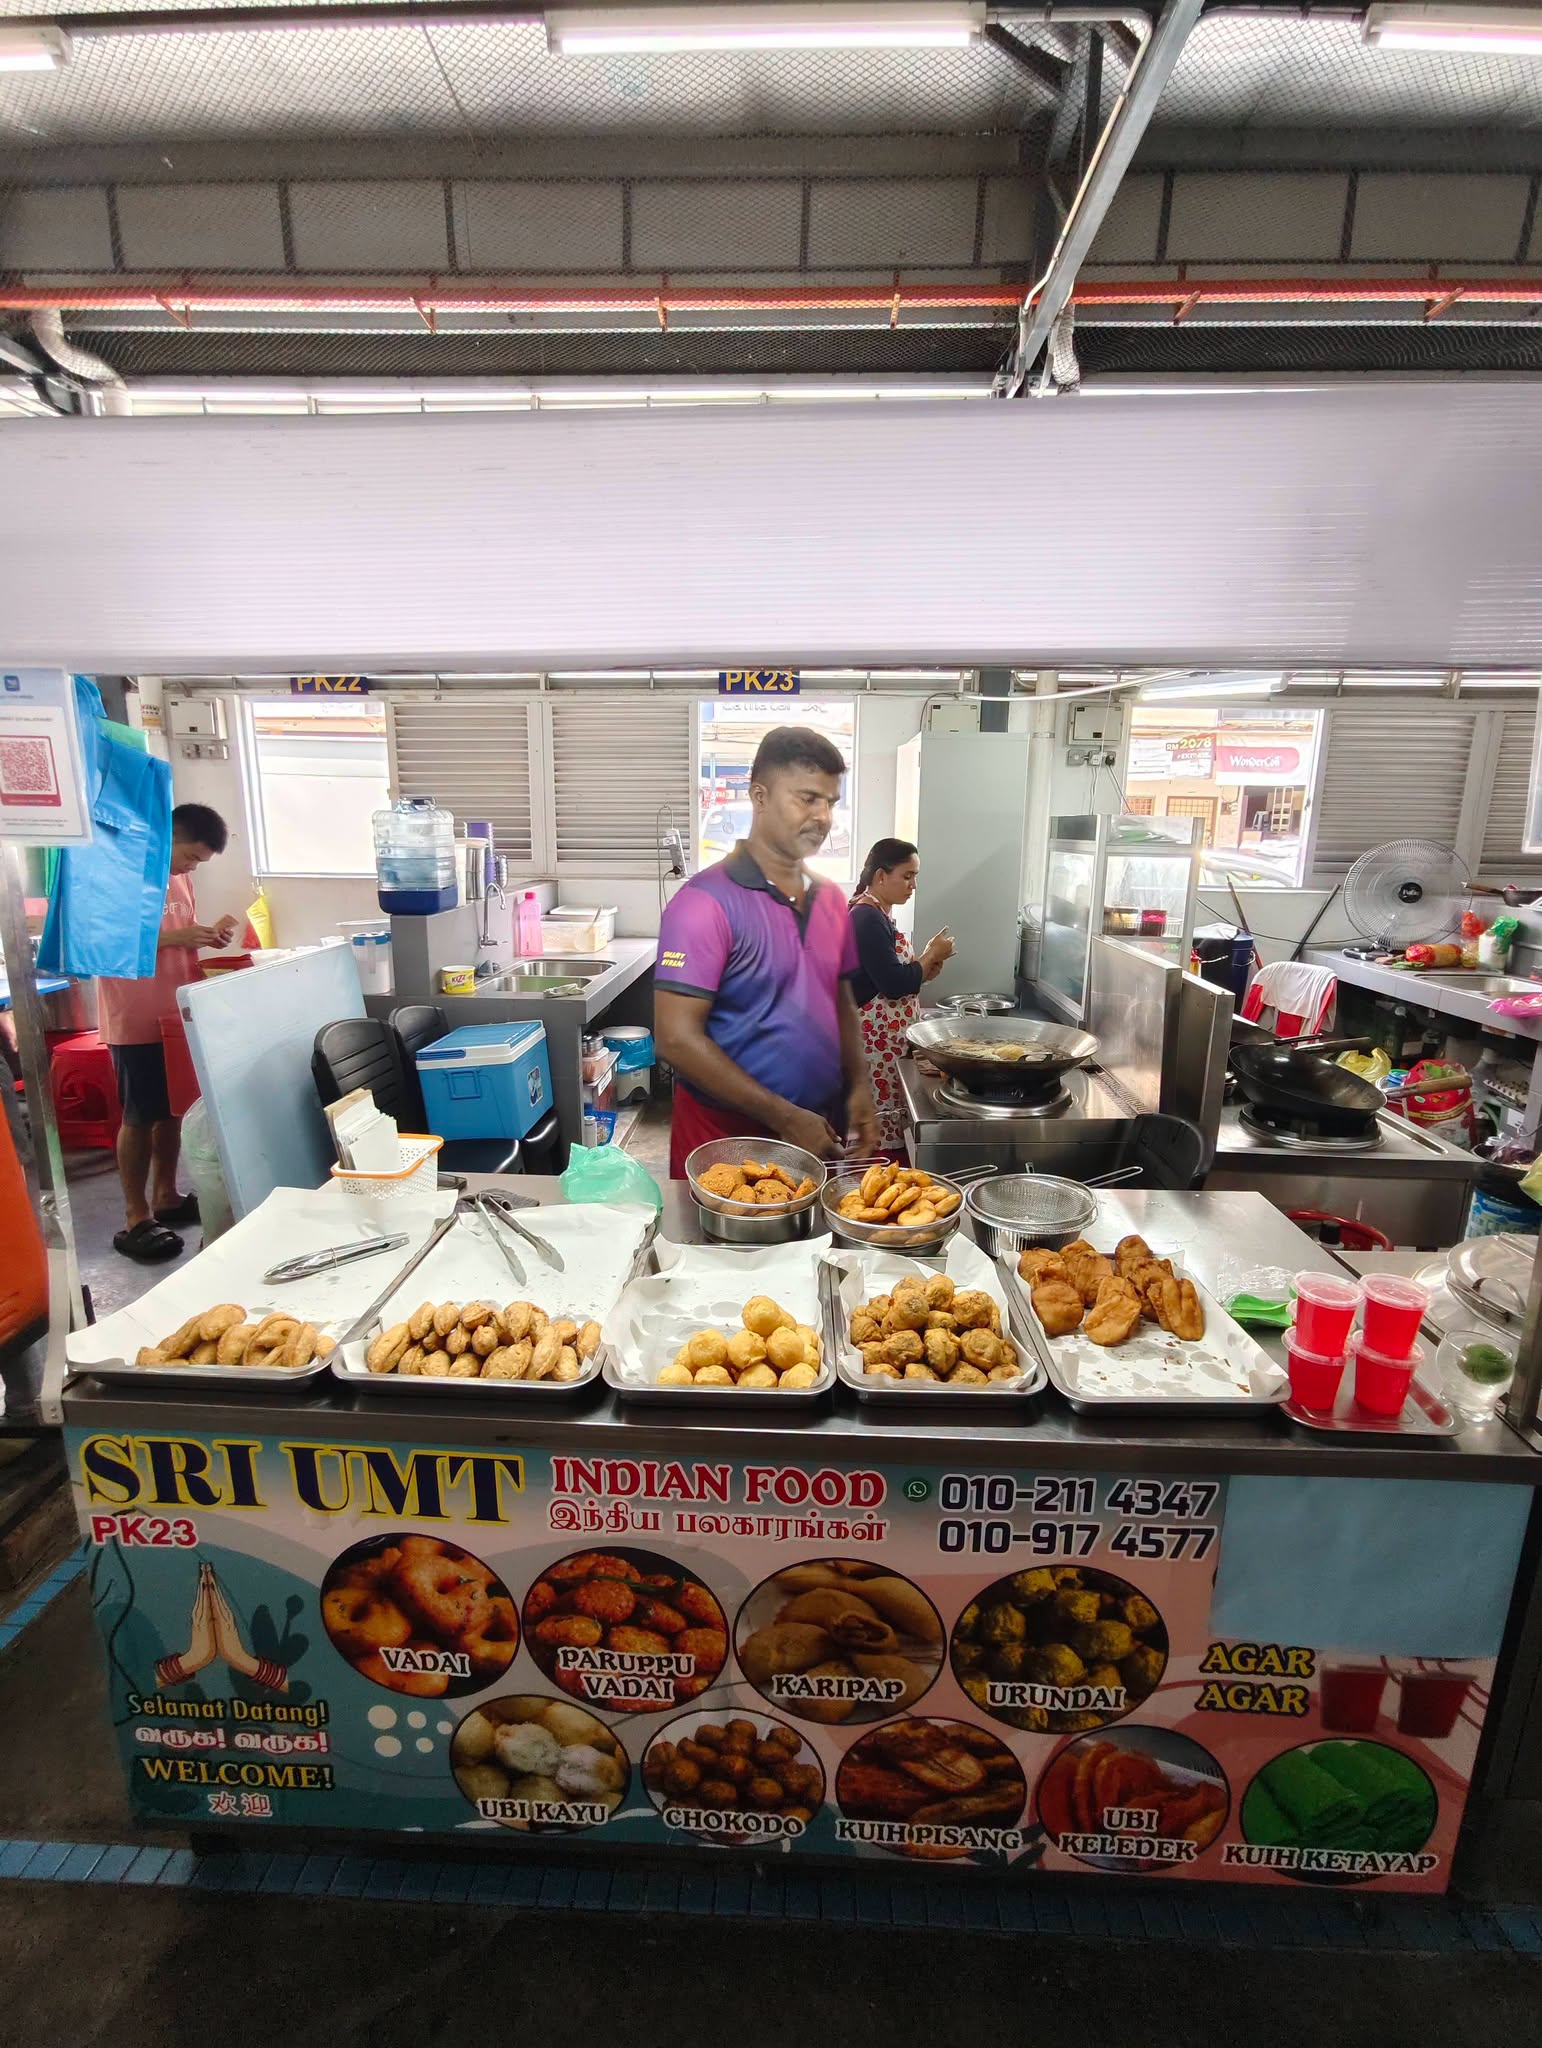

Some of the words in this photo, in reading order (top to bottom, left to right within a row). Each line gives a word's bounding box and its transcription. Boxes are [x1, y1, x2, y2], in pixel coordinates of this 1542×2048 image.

[297, 676, 362, 691] PK22
[725, 670, 794, 691] PK23
[81, 1435, 268, 1508] SRI
[281, 1443, 525, 1524] UMT
[552, 1458, 732, 1503] INDIAN
[743, 1467, 888, 1507] FOOD
[940, 1475, 1096, 1514] 010-211
[1106, 1481, 1219, 1517] 4347
[91, 1514, 198, 1547] PK23
[550, 1499, 662, 1534] இந்திய
[676, 1510, 887, 1542] பலகாரங்கள்
[938, 1520, 1101, 1557] 010-917
[1109, 1525, 1217, 1560] 4577
[381, 1649, 471, 1676] VADAI
[559, 1649, 695, 1676] PARUPPU
[1201, 1644, 1313, 1677] AGAR
[583, 1675, 674, 1700] VADAI
[774, 1676, 904, 1701] KARIPAP
[987, 1683, 1125, 1709] URUNDAI
[1197, 1682, 1308, 1715] AGAR
[128, 1694, 225, 1719] Selamat
[232, 1699, 327, 1728] Datang!
[134, 1727, 227, 1749] வருக!
[234, 1731, 329, 1754] வருக!
[141, 1757, 333, 1789] WELCOME!
[208, 1791, 272, 1816] 欢迎
[479, 1799, 530, 1821] UBI
[535, 1802, 608, 1824] KAYU
[664, 1808, 805, 1836] CHOKODO
[1104, 1808, 1159, 1832] UBI
[836, 1820, 910, 1843] KUIH
[914, 1822, 1022, 1850] PISANG
[1059, 1834, 1199, 1861] KELEDEK
[1223, 1845, 1300, 1868] KUIH
[1302, 1849, 1439, 1875] KETAYAP
